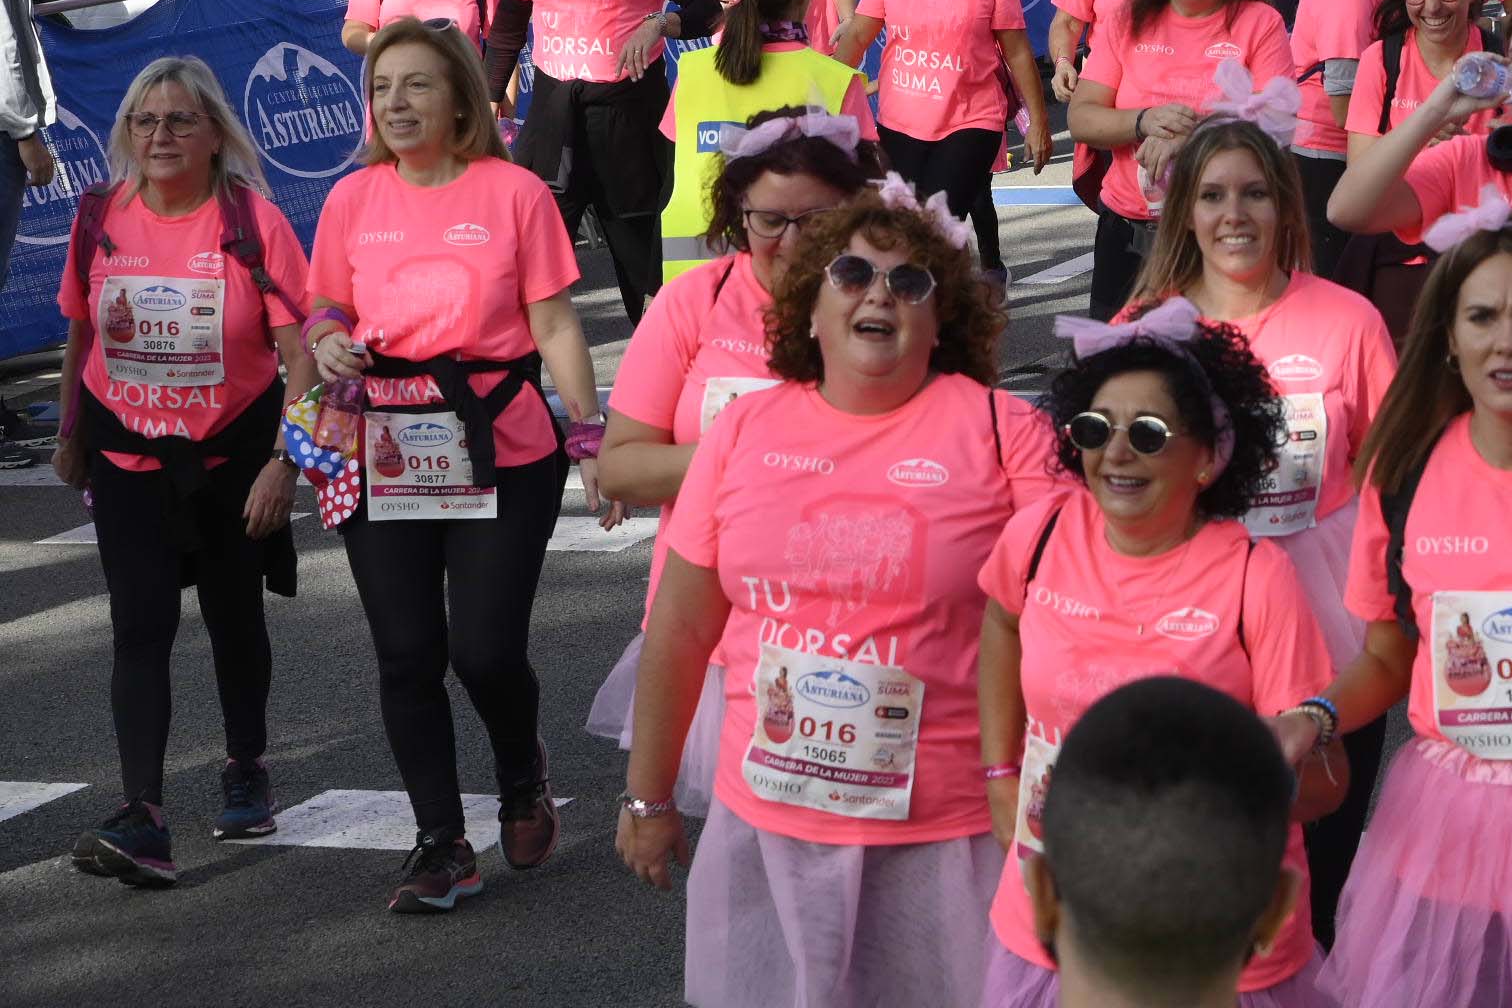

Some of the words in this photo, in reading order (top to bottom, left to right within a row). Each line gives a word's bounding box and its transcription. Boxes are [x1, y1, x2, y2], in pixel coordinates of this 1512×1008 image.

[891, 25, 910, 40] TU
[542, 37, 613, 55] DORSAL
[1135, 43, 1174, 55] OYSHO
[895, 45, 963, 72] DORSAL
[545, 63, 593, 79] SUMA
[892, 69, 942, 93] SUMA
[257, 97, 361, 150] ASTURIANA
[358, 228, 404, 244] OYSHO
[102, 254, 149, 268] OYSHO
[137, 295, 182, 305] ASTURIANA
[139, 320, 180, 336] 016
[144, 340, 175, 350] 30876
[116, 365, 147, 376] OYSHO
[177, 370, 214, 378] Santander
[107, 383, 221, 410] DORSAL
[402, 433, 449, 442] ASTURIANA
[408, 455, 450, 470] 016
[763, 452, 835, 475] OYSHO
[414, 474, 447, 483] 30877
[381, 502, 420, 512] OYSHO
[450, 501, 488, 510] Santander
[1416, 536, 1488, 555] OYSHO
[742, 576, 791, 613] TU
[801, 681, 866, 704] ASTURIANA
[878, 687, 910, 697] SUMA
[1457, 710, 1508, 722] CARRERA
[799, 717, 856, 744] 016
[1456, 734, 1511, 748] OYSHO
[804, 745, 847, 764] 15065
[765, 755, 803, 772] CARRERA
[805, 765, 819, 774] DE
[820, 768, 832, 777] LA
[834, 770, 868, 783] MUJER
[872, 775, 895, 785] 2023
[753, 773, 803, 793] OYSHO
[841, 792, 895, 808] Santander
